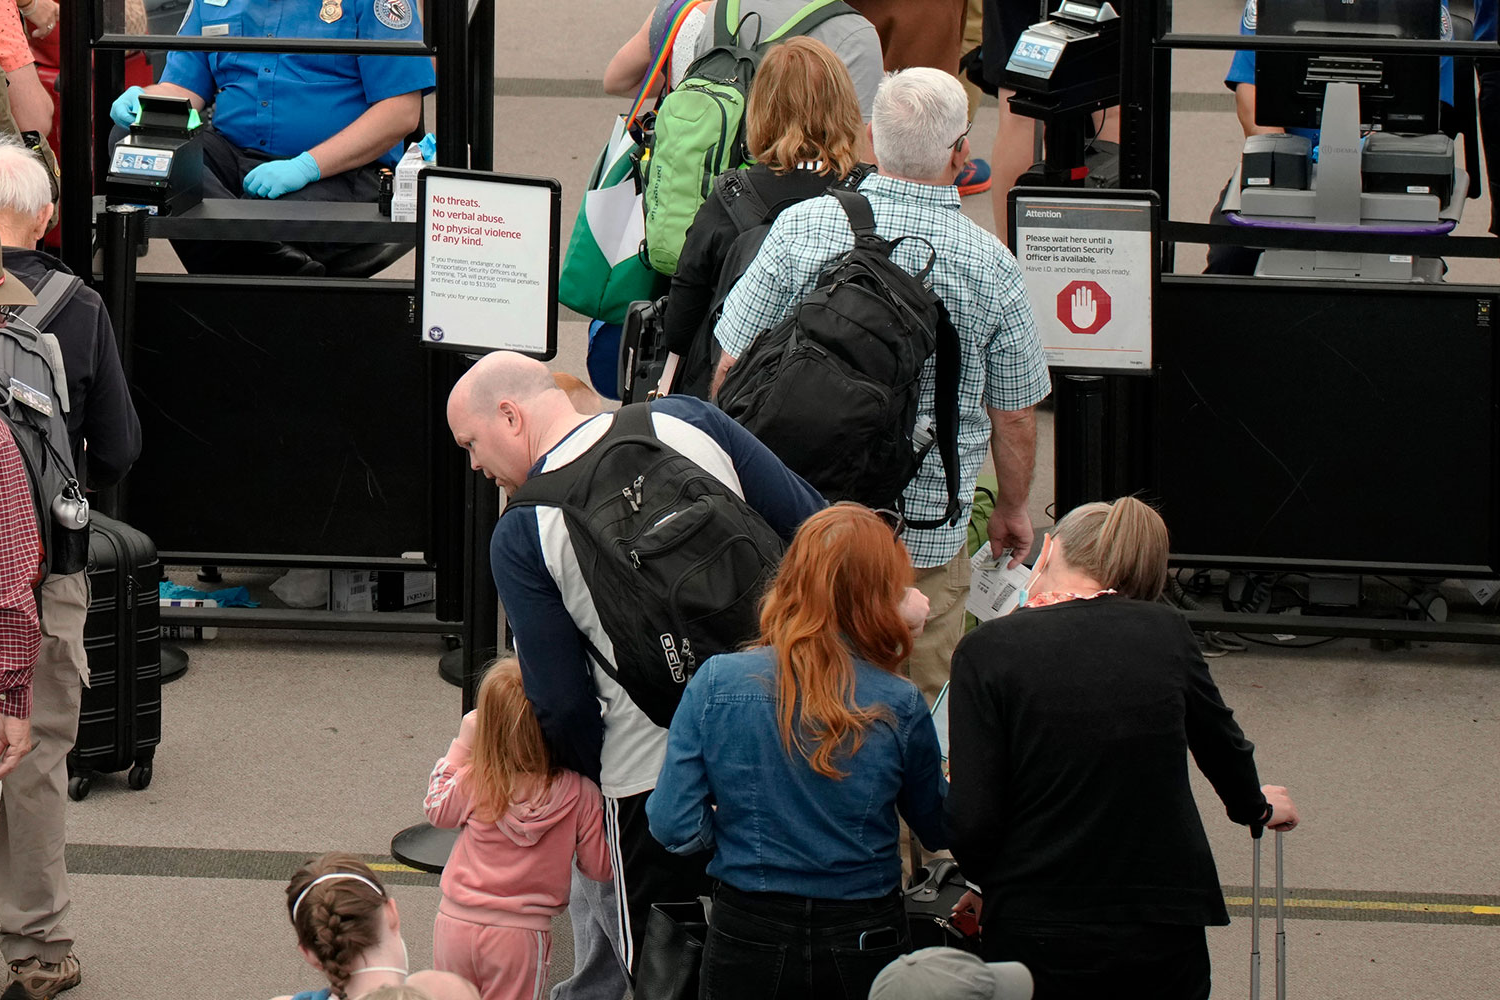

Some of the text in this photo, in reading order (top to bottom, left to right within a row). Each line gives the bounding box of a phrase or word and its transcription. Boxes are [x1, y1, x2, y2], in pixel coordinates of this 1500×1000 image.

[432, 195, 481, 208] No threats.
[432, 209, 505, 224] No verbal abuse.
[1025, 210, 1062, 218] Attention
[432, 222, 521, 240] No physical violence
[431, 233, 483, 246] of any kind.
[1025, 244, 1114, 255] Transportation Security
[1025, 253, 1051, 261] Officer
[1060, 255, 1097, 263] available.
[431, 263, 528, 279] Transportation Security Officers during
[1067, 267, 1095, 275] boarding
[479, 296, 511, 304] cooperation.
